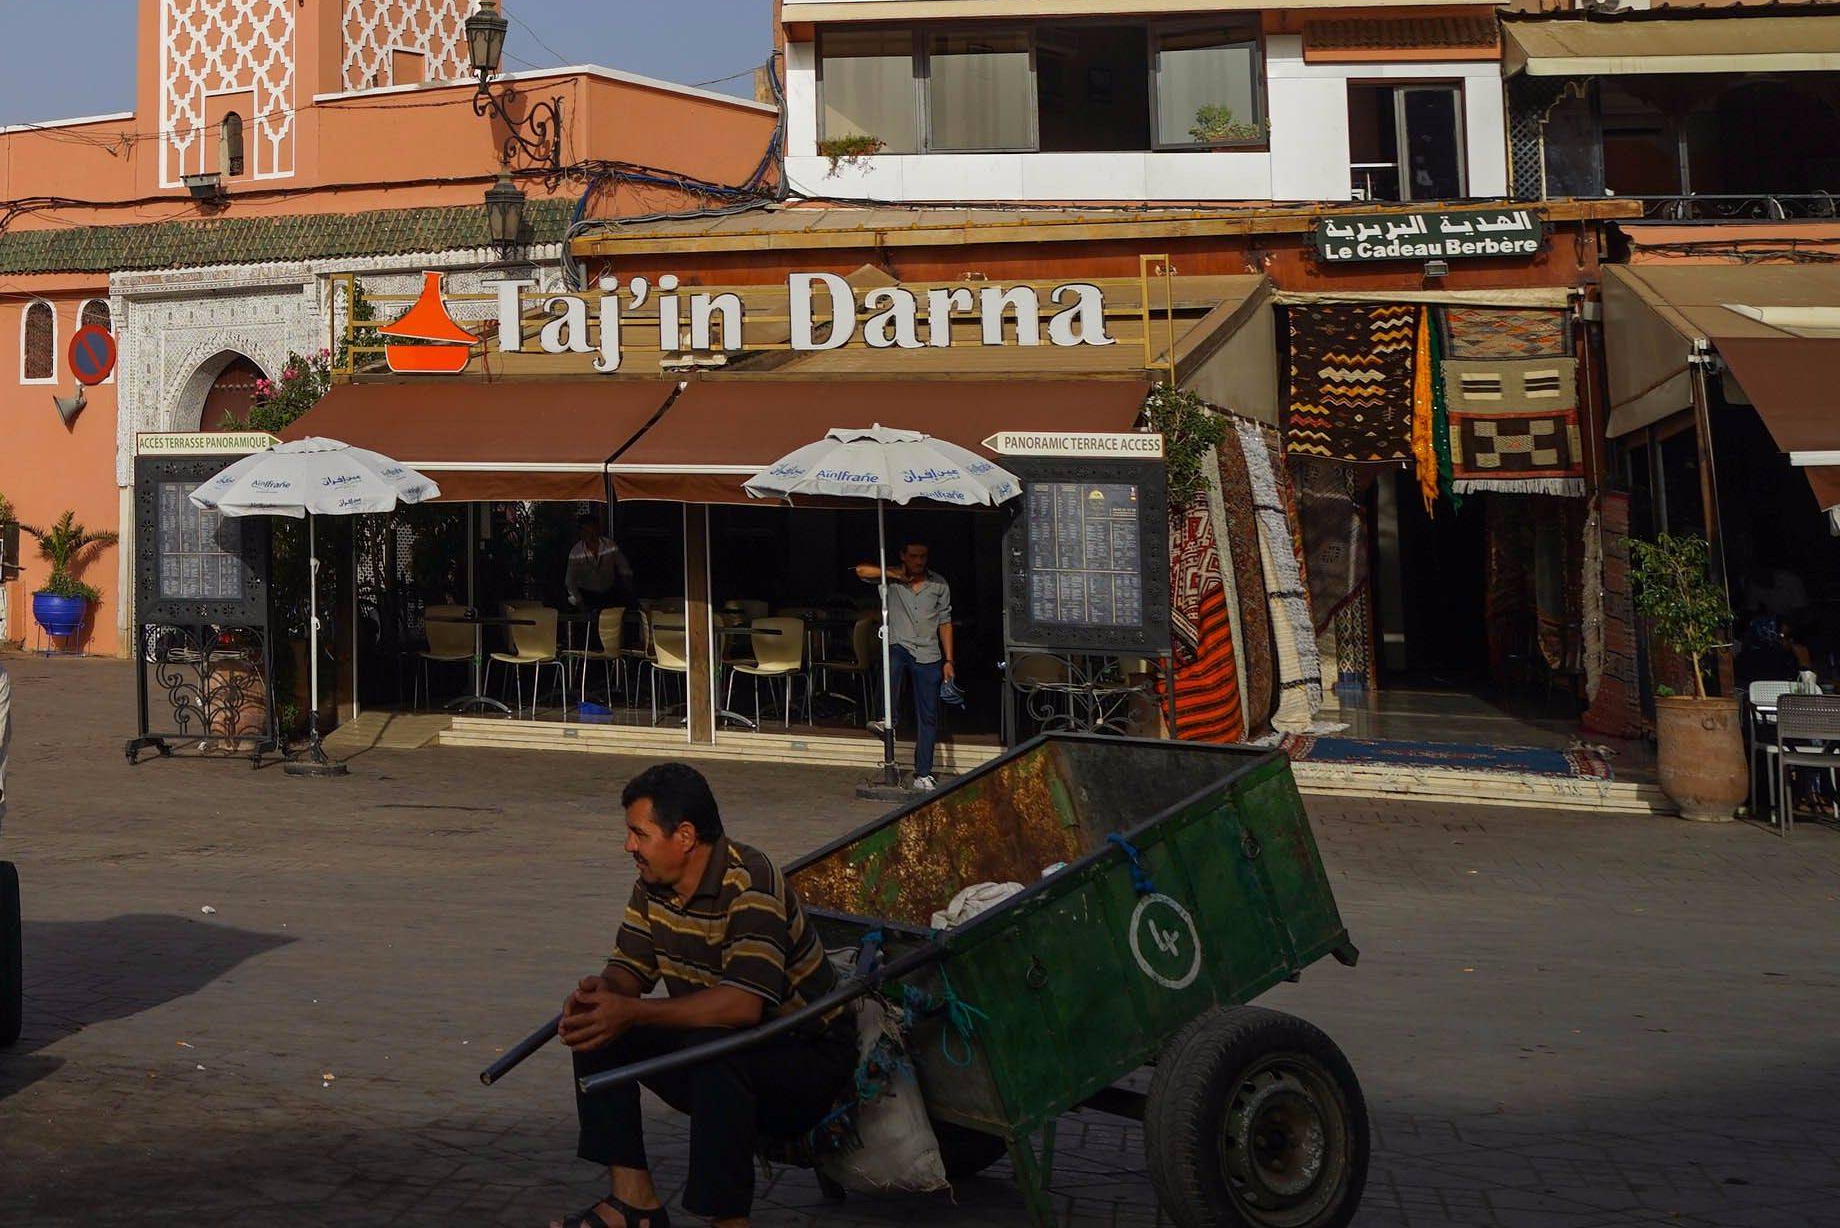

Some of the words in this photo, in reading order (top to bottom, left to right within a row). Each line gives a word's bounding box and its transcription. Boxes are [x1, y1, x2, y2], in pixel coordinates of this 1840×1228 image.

[1325, 215, 1428, 241] البربرية
[1440, 211, 1533, 235] الهدية
[1325, 243, 1352, 259] Le
[1356, 240, 1442, 258] Cadeau
[1445, 236, 1538, 255] Berbère
[480, 274, 743, 373] Taj'in
[787, 272, 1116, 351] Darna
[165, 437, 204, 449] TERRASSE
[206, 436, 266, 450] PANORAMIQUE
[1004, 437, 1069, 450] PANORAMIC
[1071, 437, 1118, 451] TERRACE
[1120, 438, 1161, 452] ACCESS
[1148, 919, 1179, 957] 4
